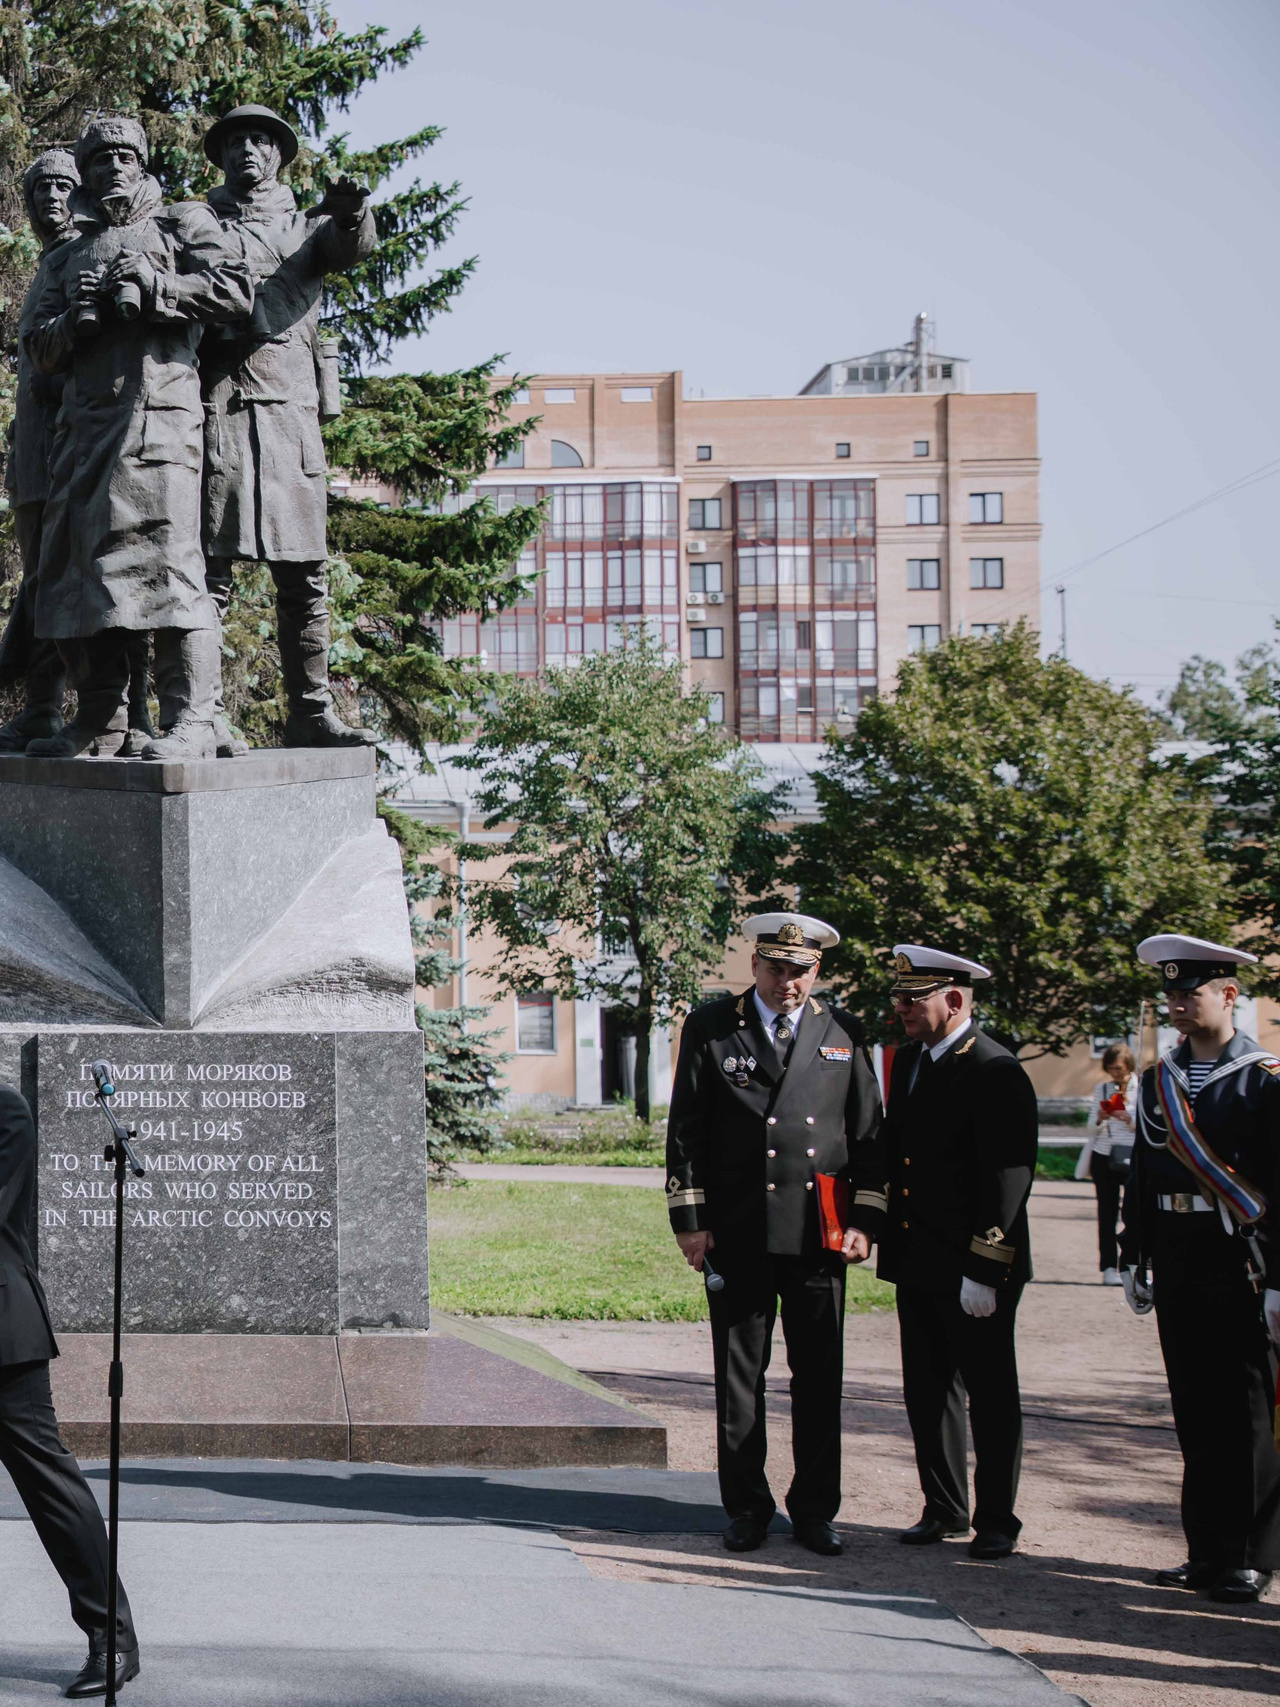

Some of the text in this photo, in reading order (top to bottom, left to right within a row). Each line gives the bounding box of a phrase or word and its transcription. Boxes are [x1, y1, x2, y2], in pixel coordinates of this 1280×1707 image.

[80, 1063, 292, 1081] ПМЯТИ МОРЯКОВ
[201, 1091, 307, 1108] КОНВОЕВ
[129, 1120, 243, 1141] 1941-1945
[50, 1154, 79, 1171] TO
[144, 1154, 241, 1172] MEMORY
[248, 1154, 276, 1172] OF
[281, 1154, 325, 1172] ALL
[61, 1181, 313, 1199] SAILORS WHO SERVED
[44, 1210, 67, 1226] IN
[131, 1209, 213, 1227] ARCTIC
[224, 1210, 332, 1228] CONVOYS
